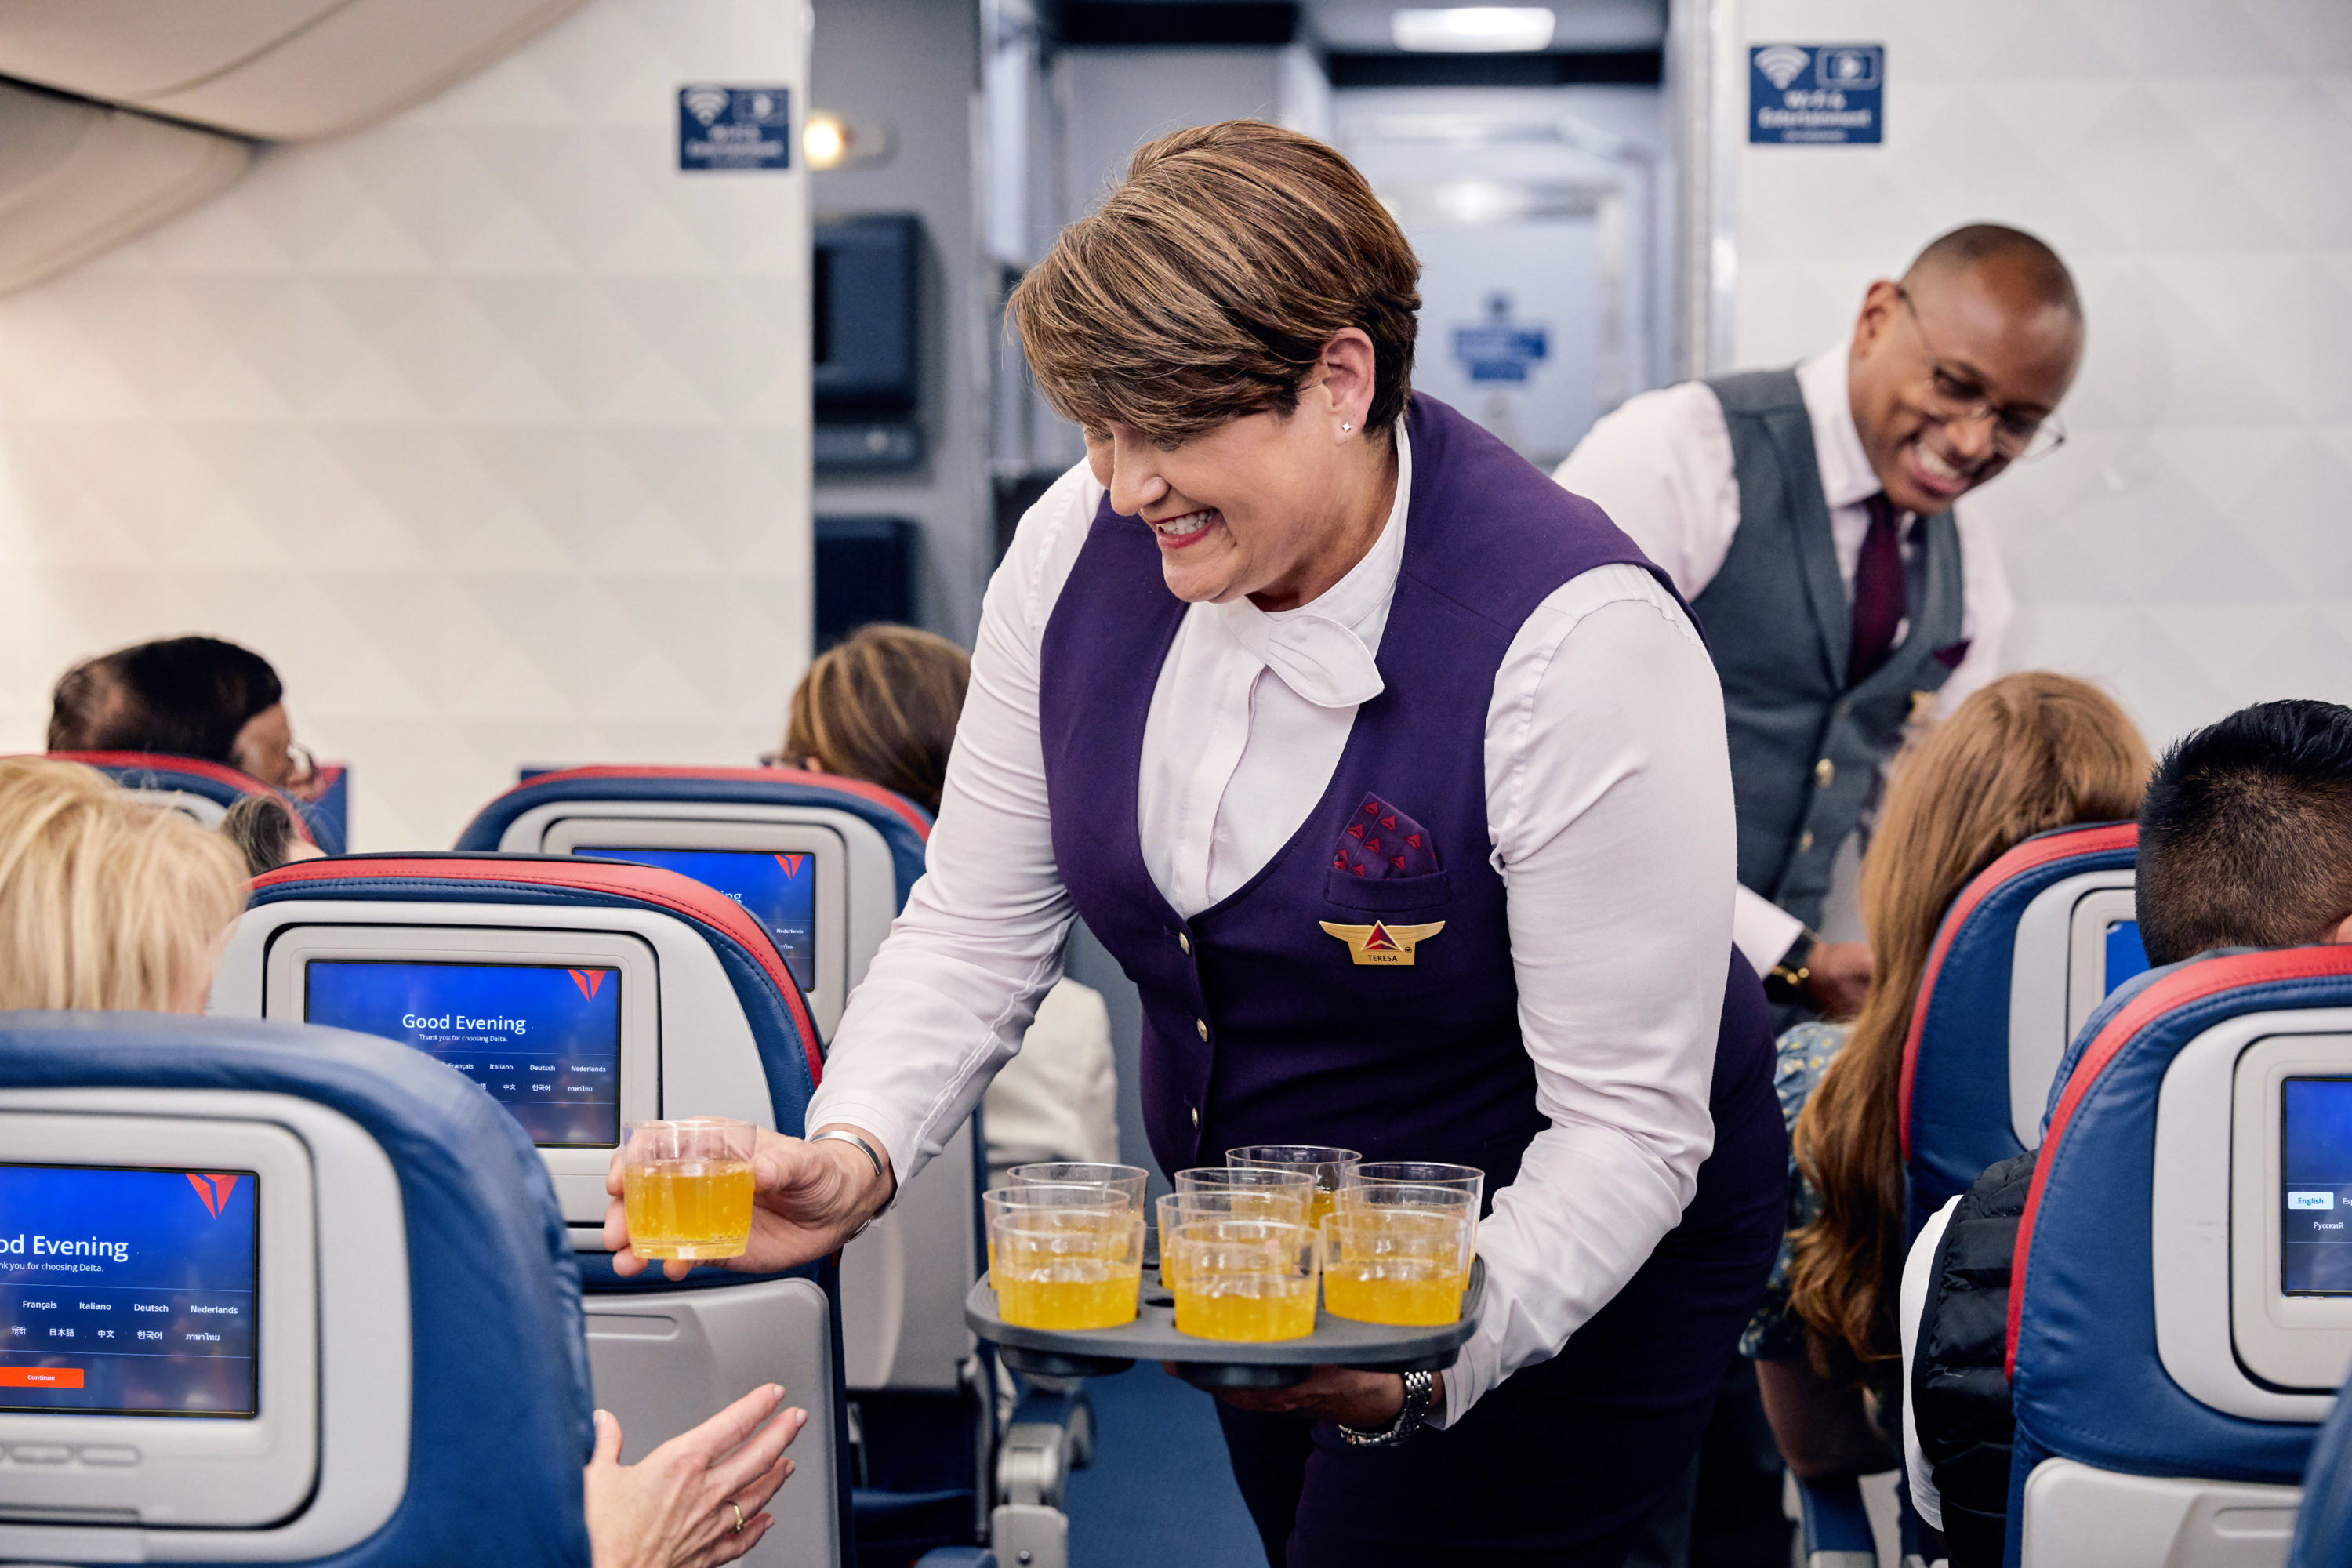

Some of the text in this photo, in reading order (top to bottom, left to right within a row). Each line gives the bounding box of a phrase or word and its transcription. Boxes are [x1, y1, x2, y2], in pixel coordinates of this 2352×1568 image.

[402, 1014, 526, 1035] Good Evening
[532, 1083, 551, 1092] 한국어
[2298, 1197, 2324, 1206] English
[2314, 1221, 2344, 1231] Русский
[34, 1235, 129, 1263] Evening
[9, 1262, 25, 1271] you
[27, 1261, 39, 1270] for
[42, 1262, 78, 1272] choosing
[79, 1263, 104, 1272] Delta.
[22, 1300, 238, 1314] Français Italiano Deutsch Nederlands
[49, 1328, 74, 1338] 日本語
[97, 1330, 115, 1338] 中文
[137, 1330, 162, 1340] 한국어
